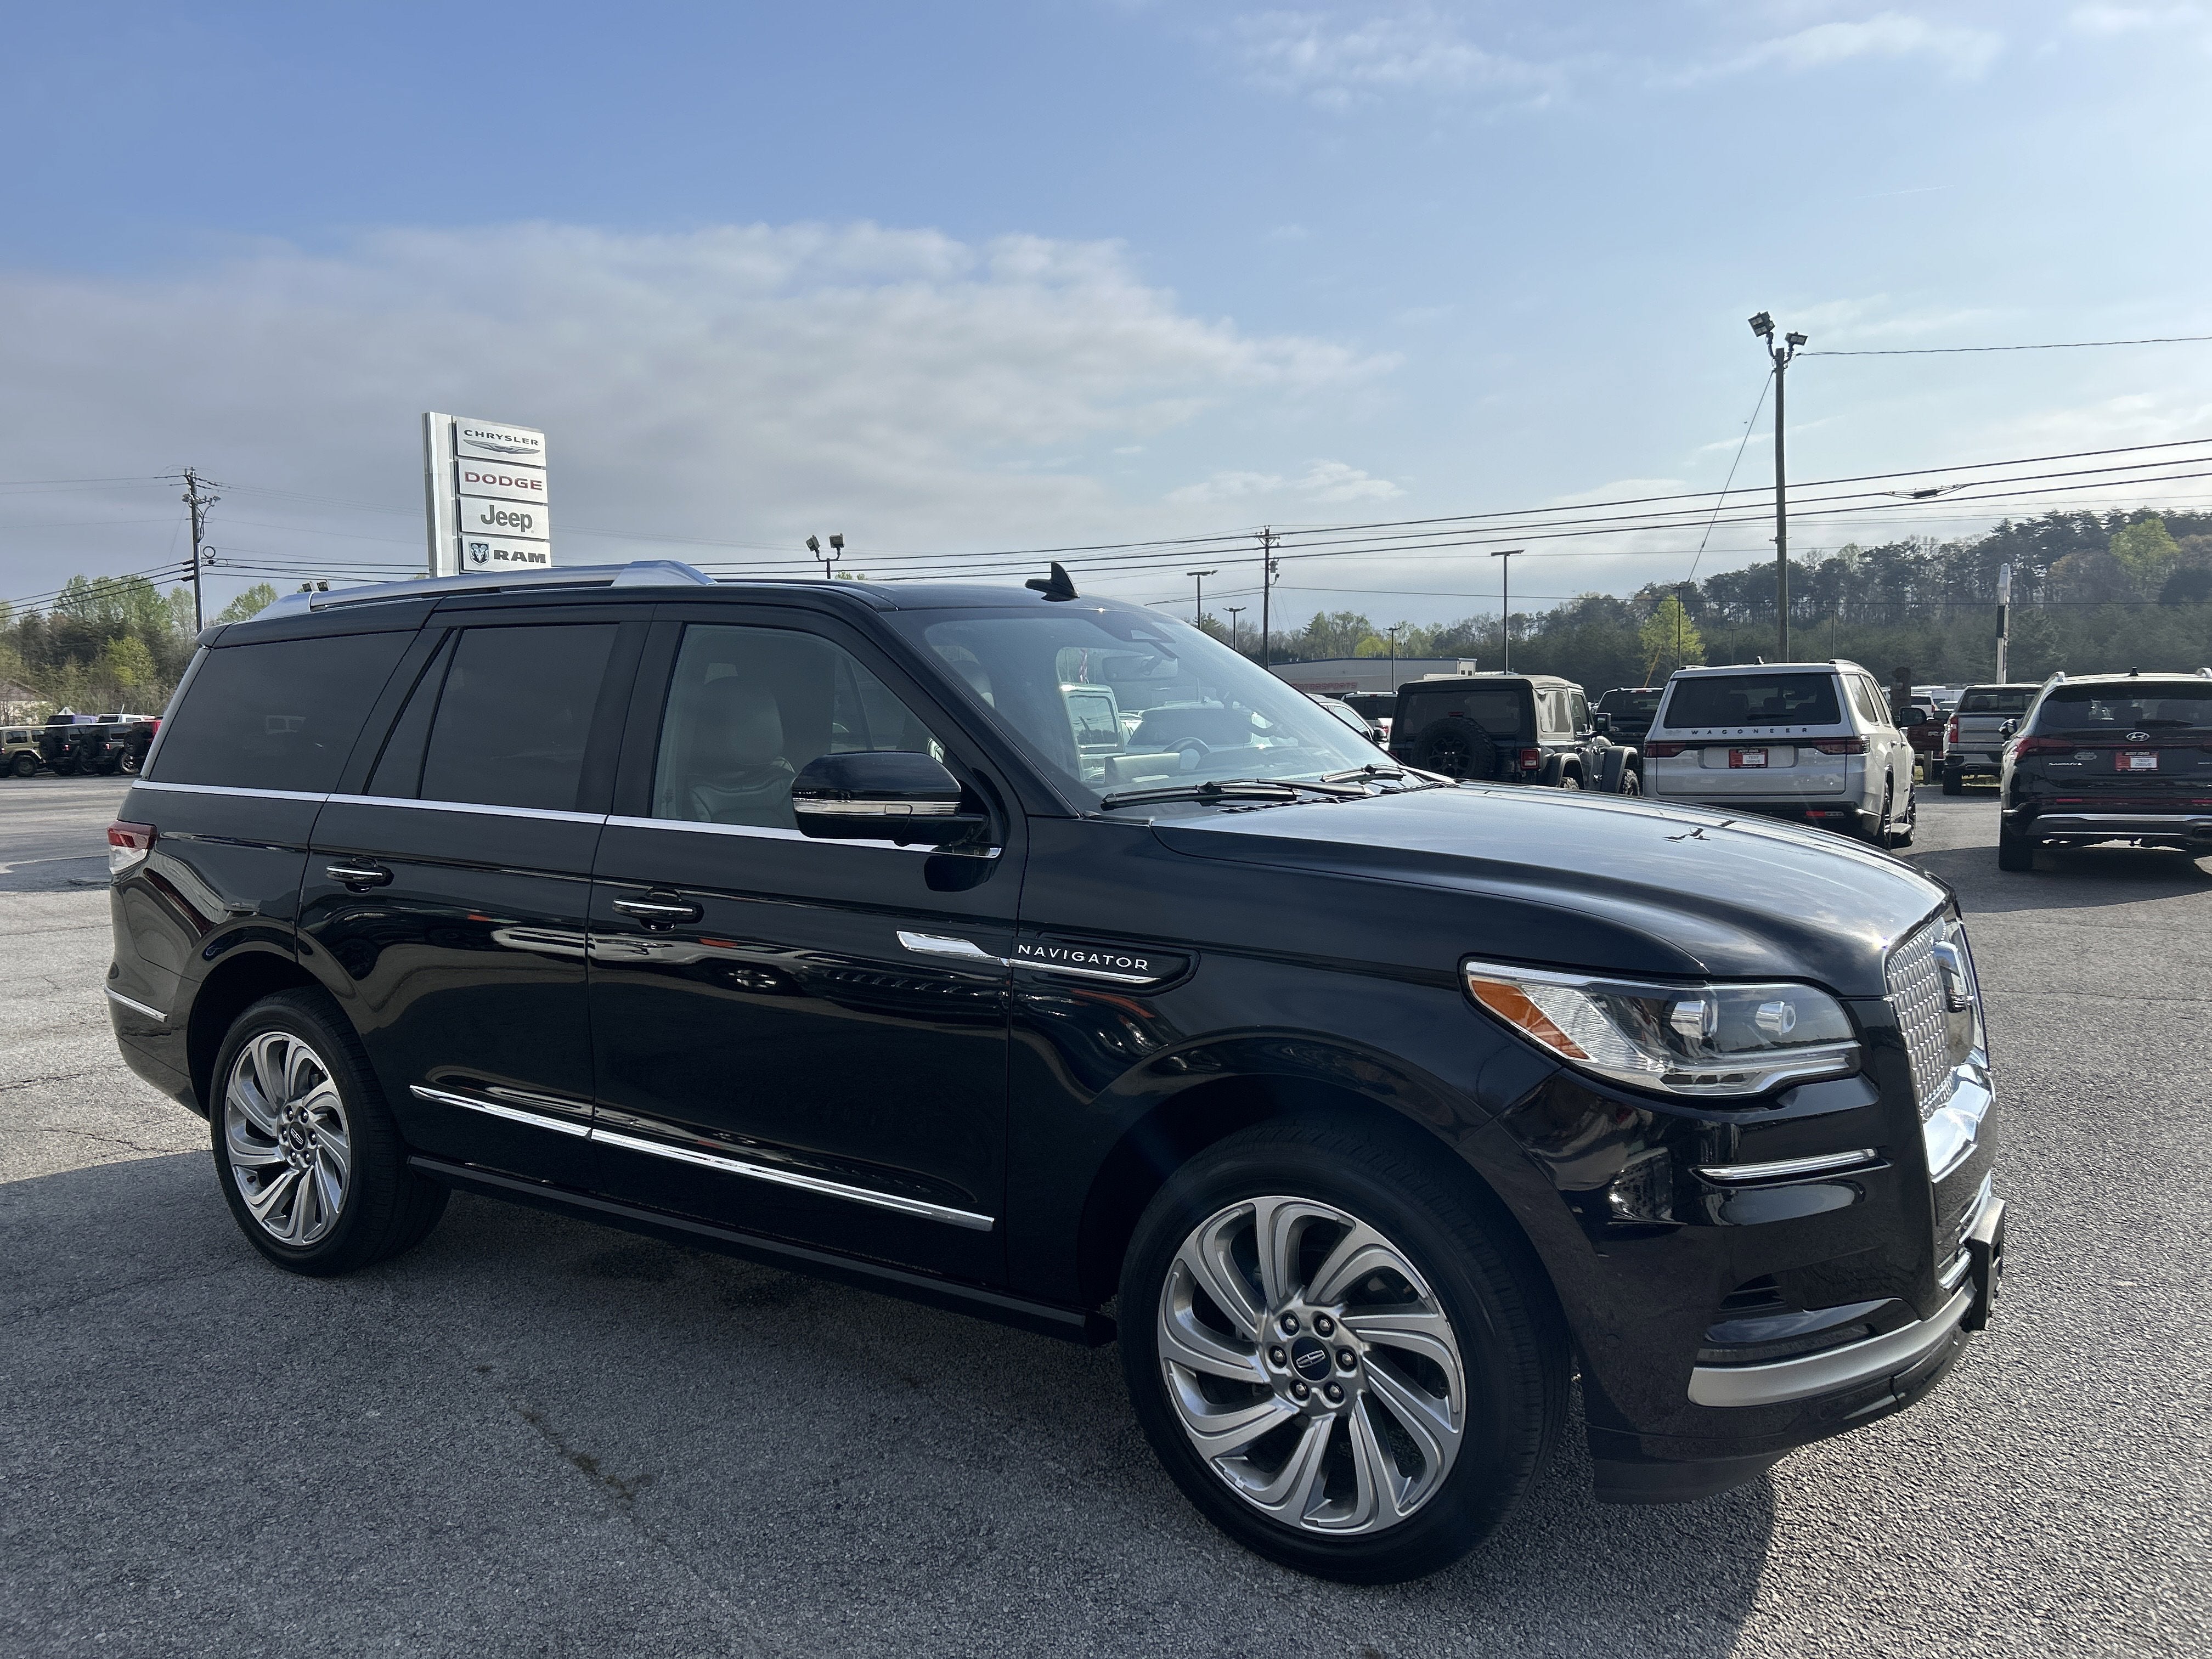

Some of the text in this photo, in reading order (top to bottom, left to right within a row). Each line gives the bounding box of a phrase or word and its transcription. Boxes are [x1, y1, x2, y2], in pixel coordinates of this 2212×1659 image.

[464, 430, 539, 445] CHRYSLER
[464, 471, 542, 490] DODGE
[480, 505, 533, 532] Jeep
[493, 549, 546, 563] RAM
[1691, 727, 1808, 735] WAGONEER
[1018, 944, 1149, 972] NAVIGATOR
